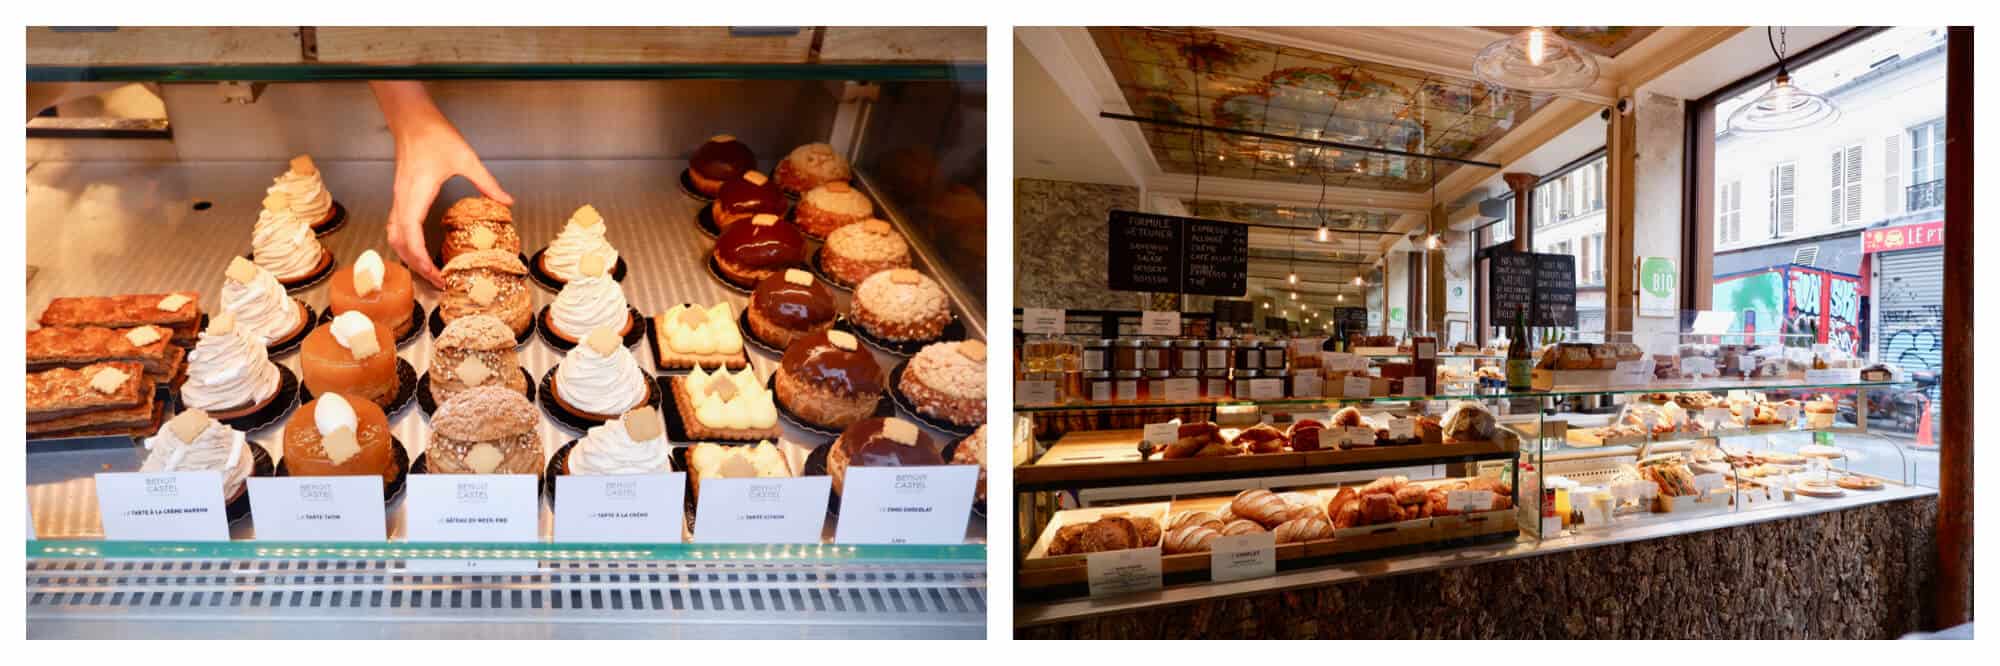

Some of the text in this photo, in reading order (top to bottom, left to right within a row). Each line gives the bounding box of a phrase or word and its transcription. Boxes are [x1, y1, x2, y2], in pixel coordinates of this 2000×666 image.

[1908, 226, 1924, 245] LE
[895, 473, 929, 482] BENOIT
[894, 481, 927, 489] CASTEL
